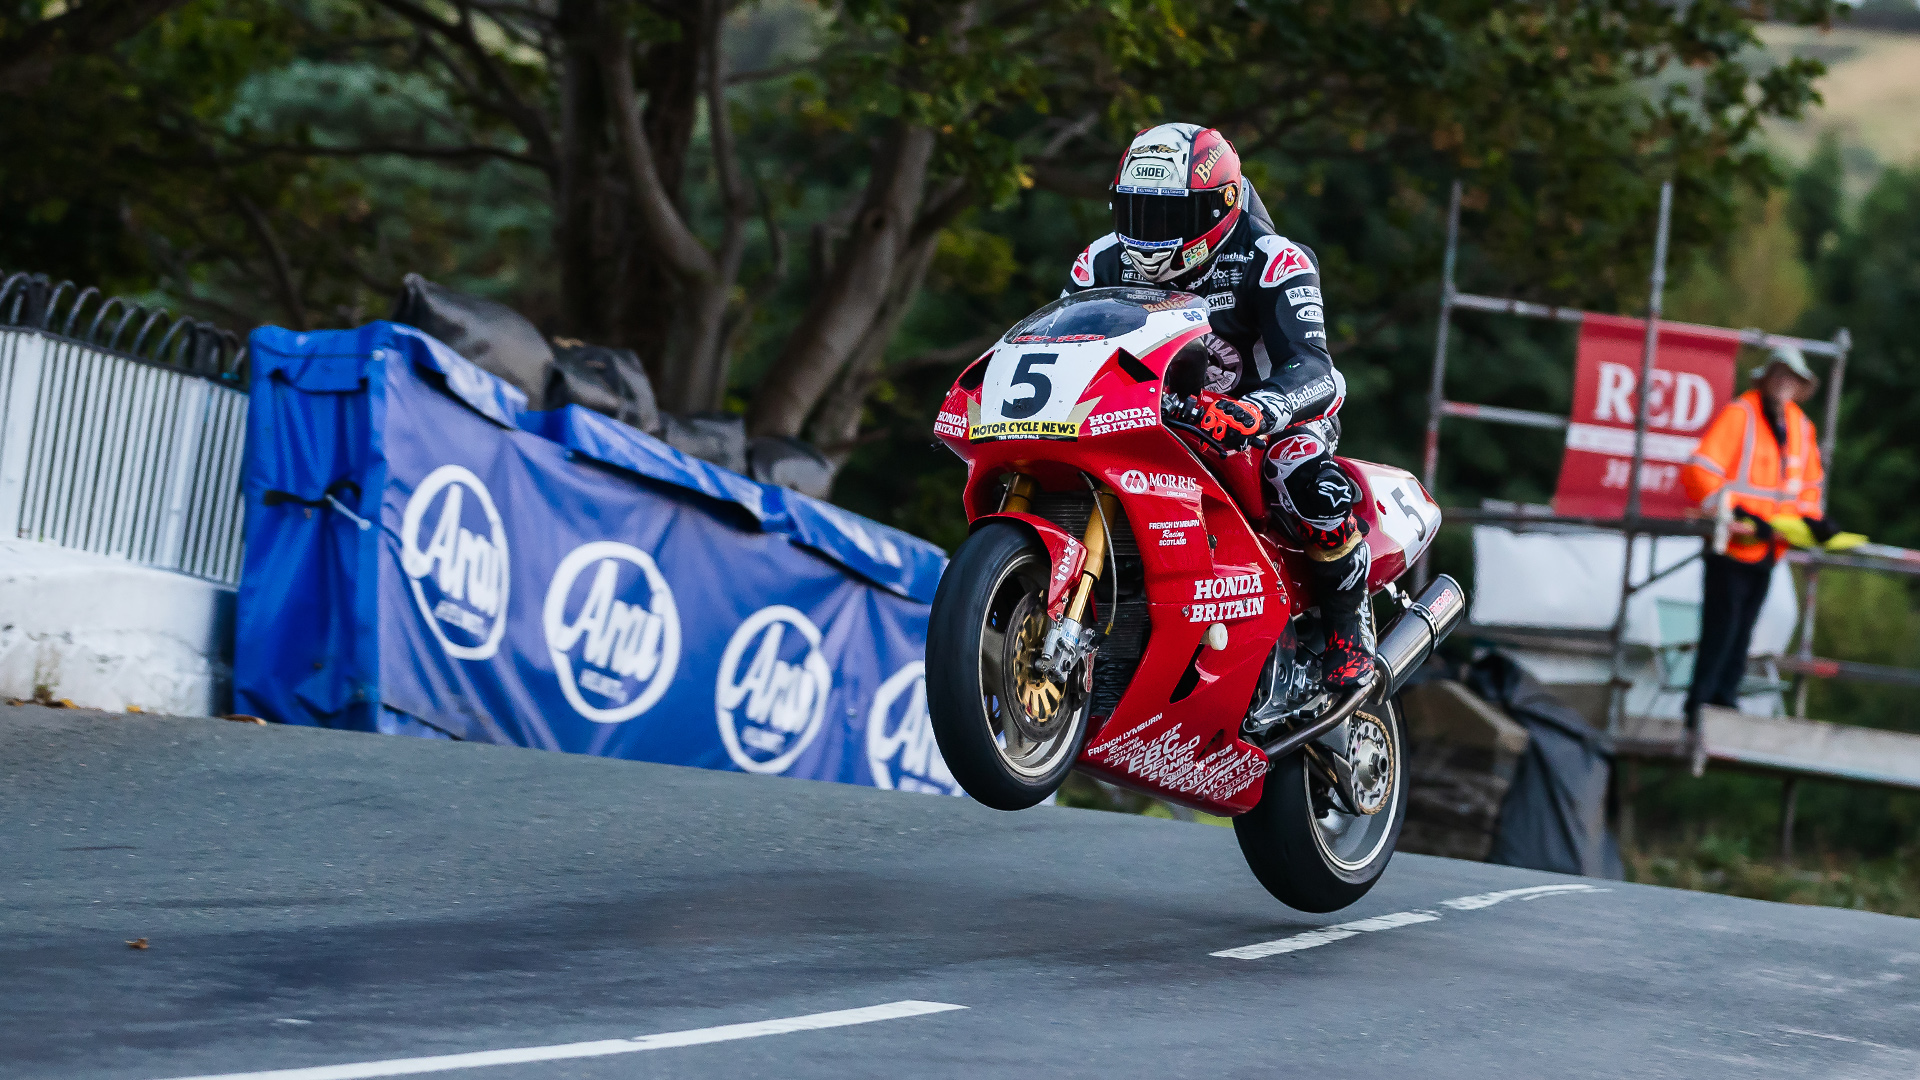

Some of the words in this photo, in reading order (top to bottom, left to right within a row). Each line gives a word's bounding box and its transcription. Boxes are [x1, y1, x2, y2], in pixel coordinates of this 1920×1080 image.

[1136, 166, 1165, 178] SHOEI
[1212, 268, 1230, 280] ebc
[1000, 352, 1060, 420] 5
[1594, 361, 1714, 432] RED
[936, 411, 968, 428] HONDA
[1088, 406, 1156, 426] HONDA
[1090, 416, 1158, 436] BRITAIN
[971, 423, 1006, 438] MOTOR
[1008, 422, 1040, 432] CYCLE
[1042, 422, 1076, 434] NEWS
[1149, 472, 1196, 492] MORRIS
[1148, 520, 1173, 530] FRENCH
[1173, 518, 1200, 529] LYMBURN
[1390, 487, 1427, 542] 5
[1158, 538, 1187, 546] SCOTLAND
[1162, 530, 1185, 542] Racing
[1055, 534, 1078, 581] UNLOP
[1194, 574, 1264, 600] HONDA
[1190, 596, 1265, 623] BRITAIN
[1088, 736, 1122, 757] FRENCH
[1123, 713, 1163, 740] LYMBURN
[1108, 736, 1140, 756] Racing
[1110, 722, 1182, 768] DUNLOP
[1104, 740, 1144, 764] SCOTLAND
[1128, 734, 1180, 774] EBC
[1140, 735, 1201, 778] DENSO
[1148, 750, 1194, 782] SONIC
[1169, 744, 1234, 790] GOODRIDGE
[1203, 754, 1260, 795] MORRIS
